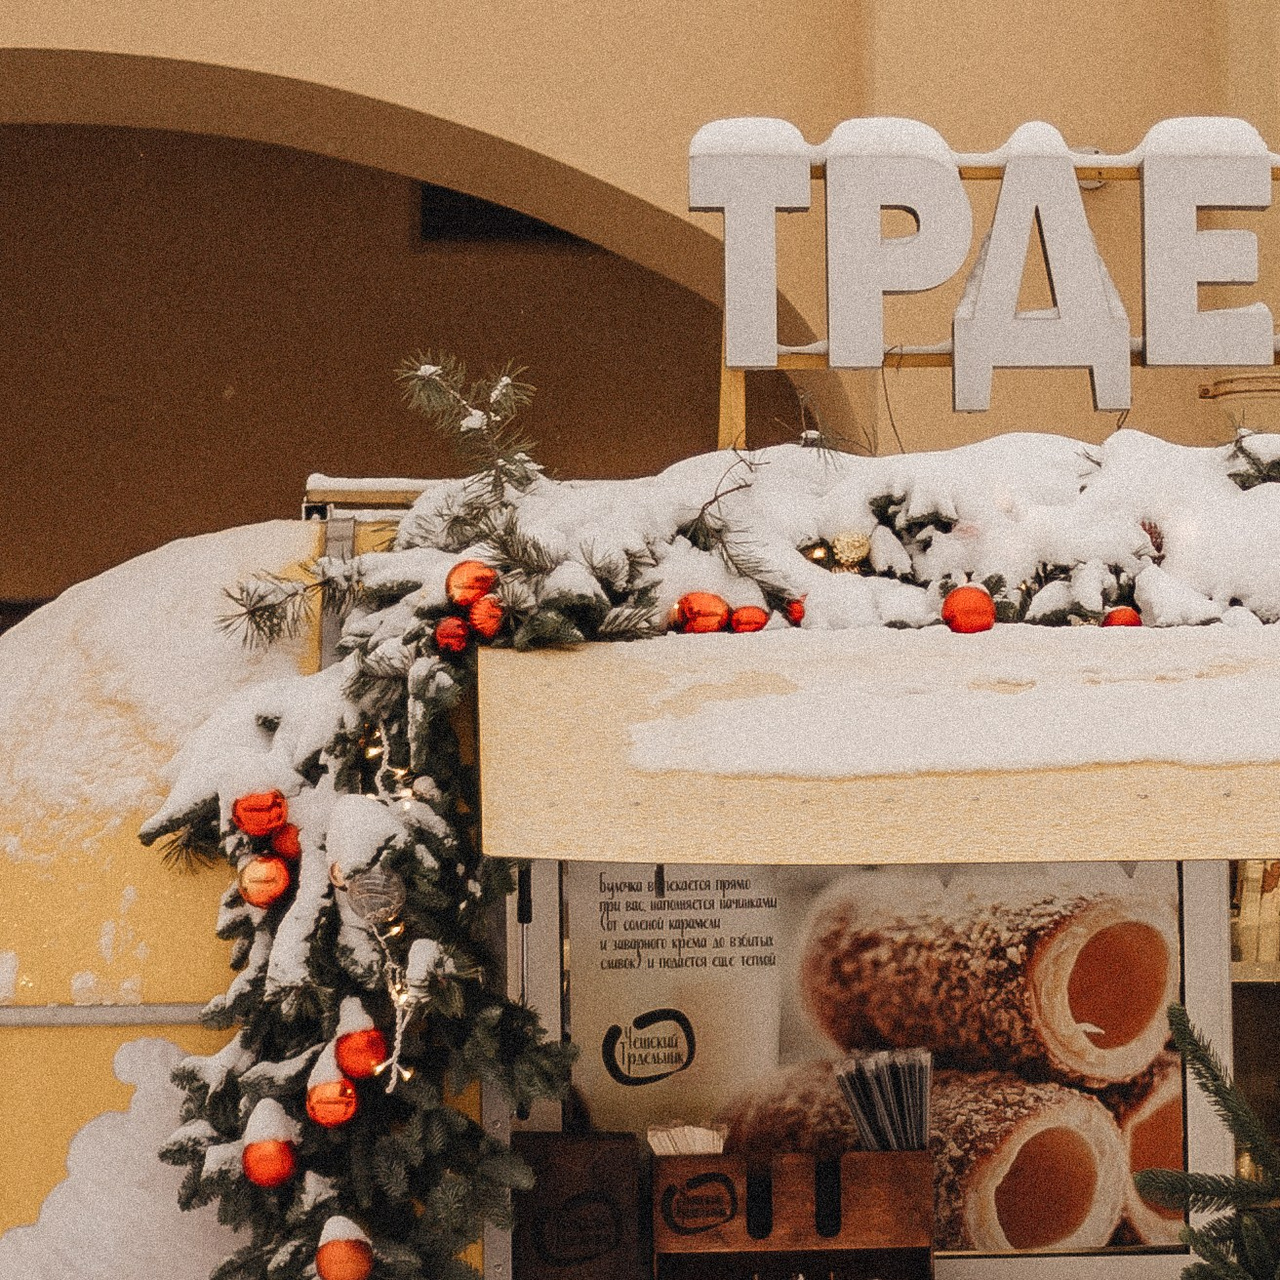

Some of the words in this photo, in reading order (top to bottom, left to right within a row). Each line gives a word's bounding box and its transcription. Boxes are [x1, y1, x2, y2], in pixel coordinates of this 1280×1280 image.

[599, 872, 642, 899] Булочка
[715, 879, 751, 899] прямо
[599, 900, 621, 921] при
[650, 898, 715, 911] наполняется
[720, 897, 777, 910] начинками
[600, 913, 618, 931] (от
[623, 917, 664, 931] соленой
[669, 918, 721, 937] карамели
[600, 940, 607, 951] и
[613, 938, 667, 954] заварного
[671, 937, 707, 956] крема
[712, 937, 725, 949] до
[729, 933, 774, 948] взбитых
[600, 950, 642, 970] сливок)
[647, 958, 655, 969] и
[659, 956, 707, 969] подается
[712, 956, 734, 968] еще
[741, 953, 776, 967] теплой
[624, 1026, 679, 1049] Чешский
[620, 1041, 684, 1074] Трдельник
